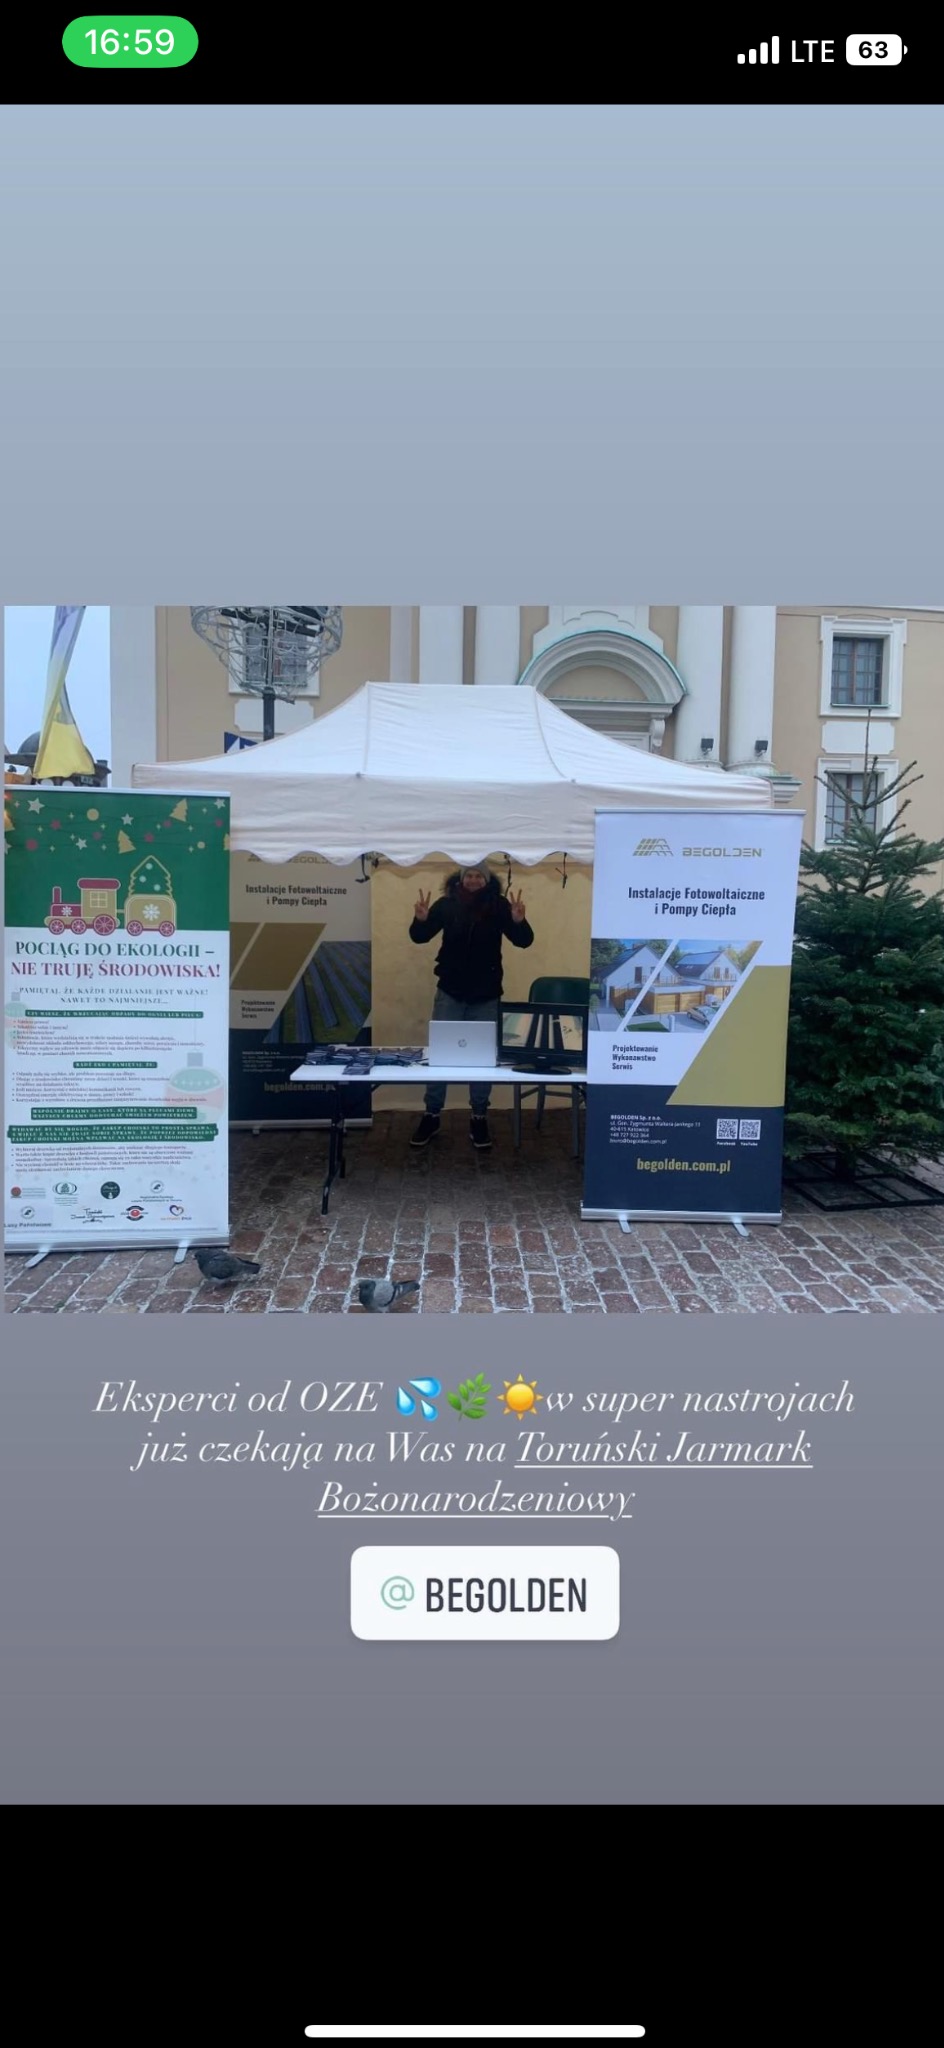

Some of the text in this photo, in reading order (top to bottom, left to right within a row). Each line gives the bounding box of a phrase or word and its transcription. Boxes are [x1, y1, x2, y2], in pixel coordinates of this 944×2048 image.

[683, 848, 762, 857] BEGOLDEN
[245, 884, 347, 895] Instalacje Fotowoltaiczne
[628, 887, 765, 901] Instalacje Fotowoltaiczne
[266, 896, 327, 907] i Pompy Ciepła
[655, 903, 736, 918] i Pompy Ciepła
[15, 941, 79, 958] POCIĄG
[85, 942, 111, 956] DO
[116, 943, 200, 958] EKOLOGII
[11, 959, 220, 979] NIE TRUJĘ ŚRODOWISKA!
[77, 986, 105, 995] KAŻDE
[156, 988, 174, 996] JEST
[177, 988, 208, 996] WAŻNE!
[612, 1044, 659, 1054] Projektowanie
[612, 1053, 657, 1063] Wykonawstwo
[612, 1062, 633, 1071] Serwis
[636, 1158, 731, 1174] begolden.com.pl
